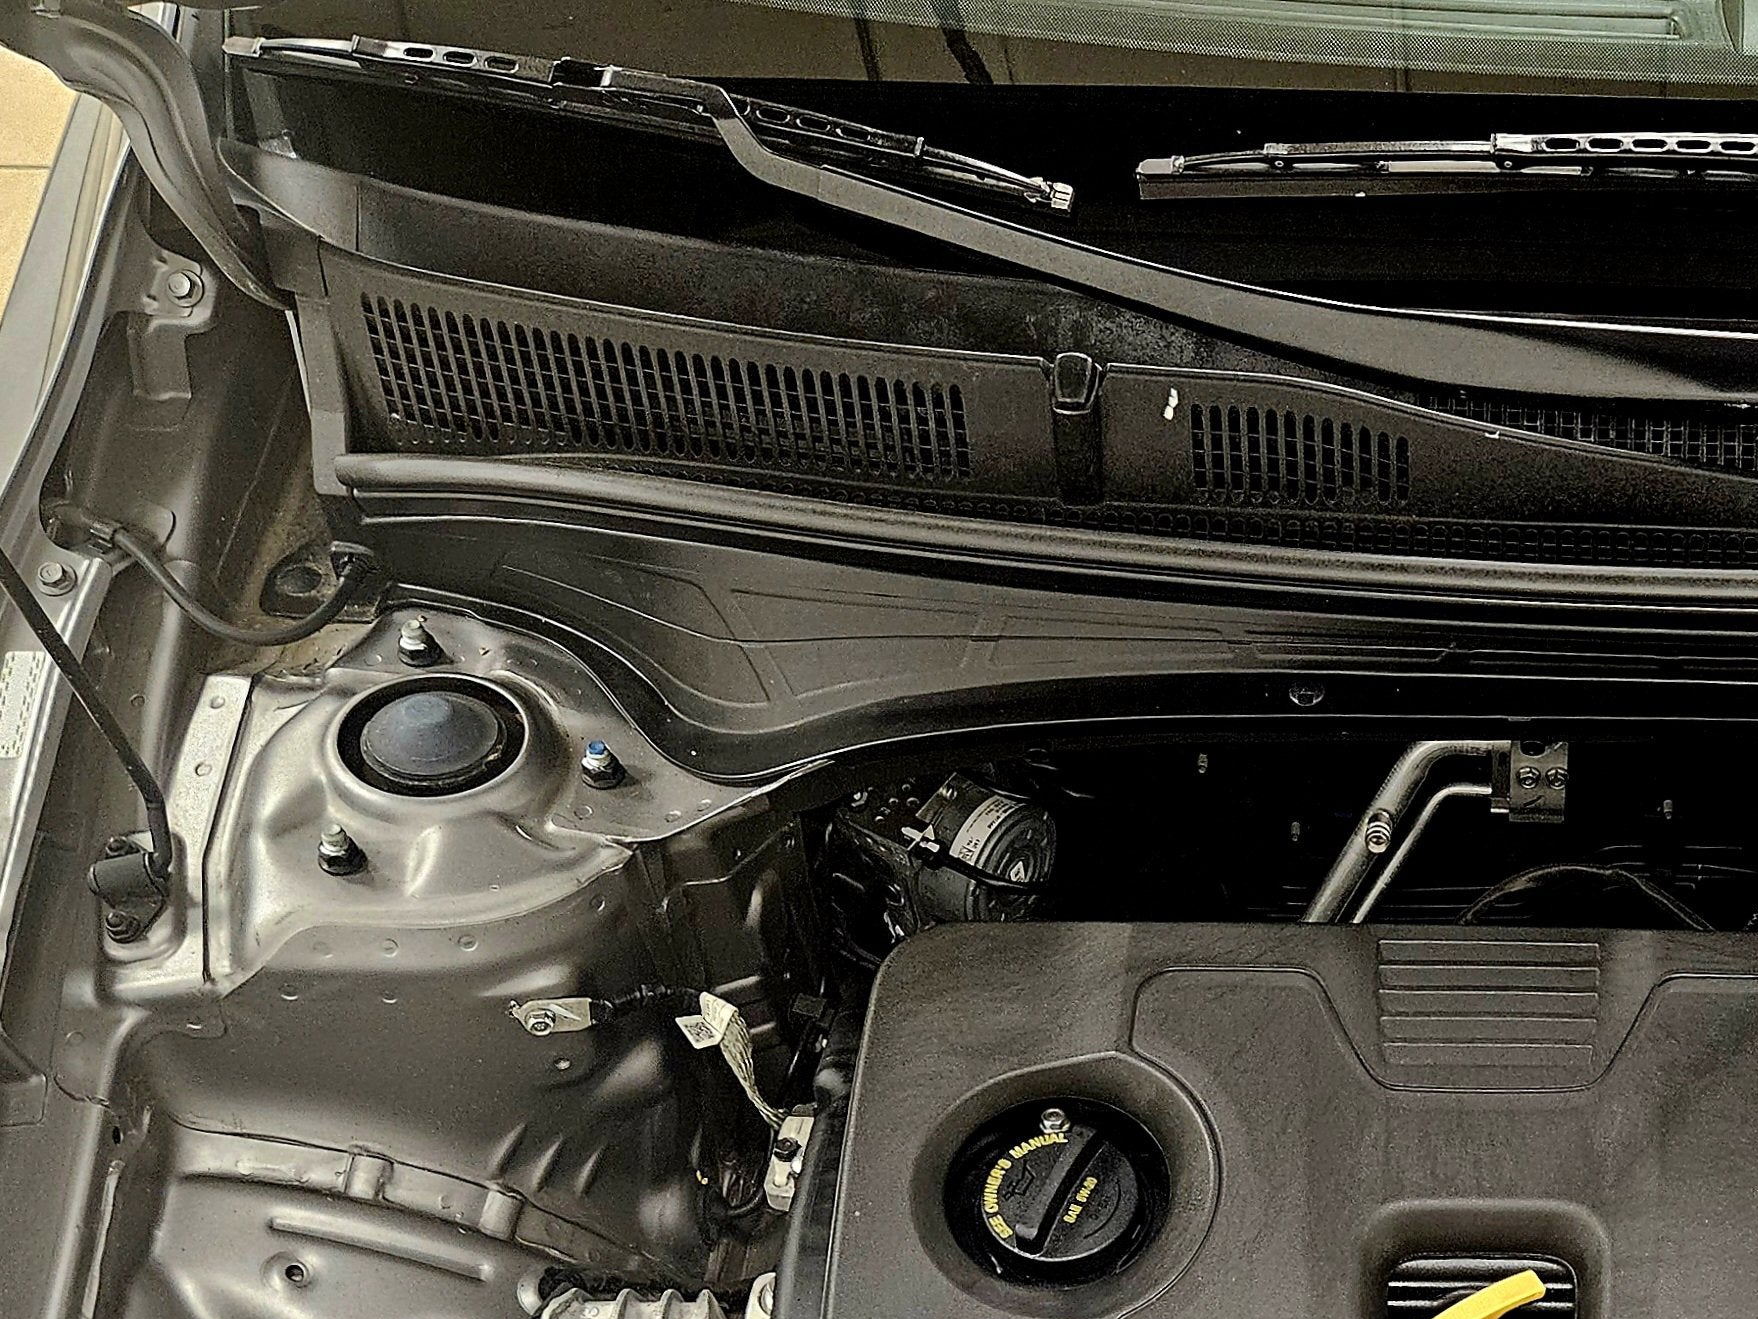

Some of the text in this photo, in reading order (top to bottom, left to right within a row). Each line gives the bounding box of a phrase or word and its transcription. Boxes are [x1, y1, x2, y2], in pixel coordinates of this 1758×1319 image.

[983, 1132, 1069, 1240] SEE OWNER'S MANUAL
